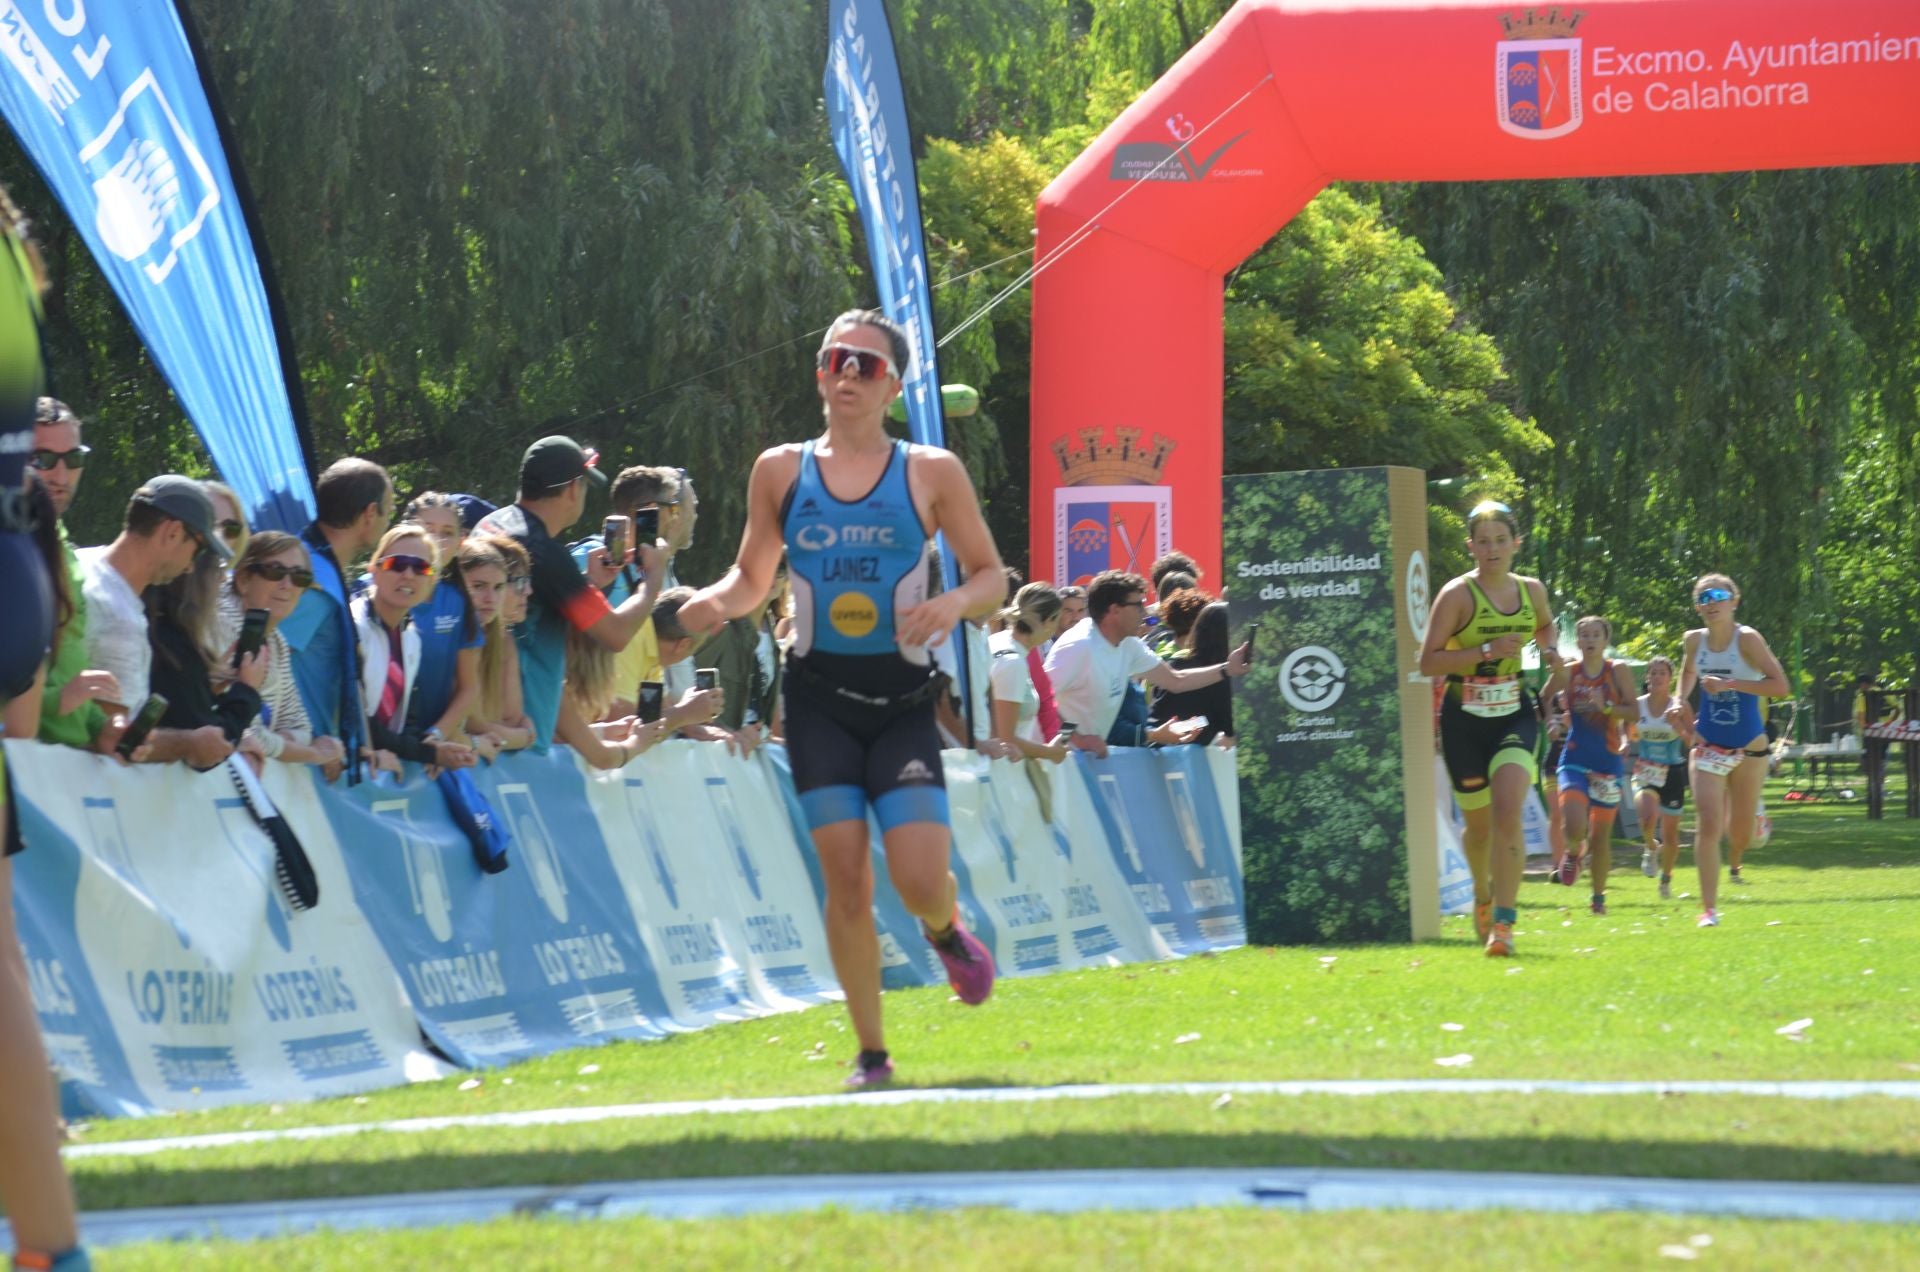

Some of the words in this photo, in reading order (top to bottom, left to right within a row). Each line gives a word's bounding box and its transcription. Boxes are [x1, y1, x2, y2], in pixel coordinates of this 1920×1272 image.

[1592, 46, 1713, 77] Excmo.
[1723, 32, 1920, 77] Ayuntamien
[1592, 84, 1633, 114] de
[1644, 79, 1809, 112] Calahorra
[842, 525, 896, 544] mrc
[1237, 553, 1381, 577] Sostenibilidad
[1259, 583, 1286, 600] de
[1291, 579, 1360, 598] verdad
[1309, 729, 1354, 741] circular
